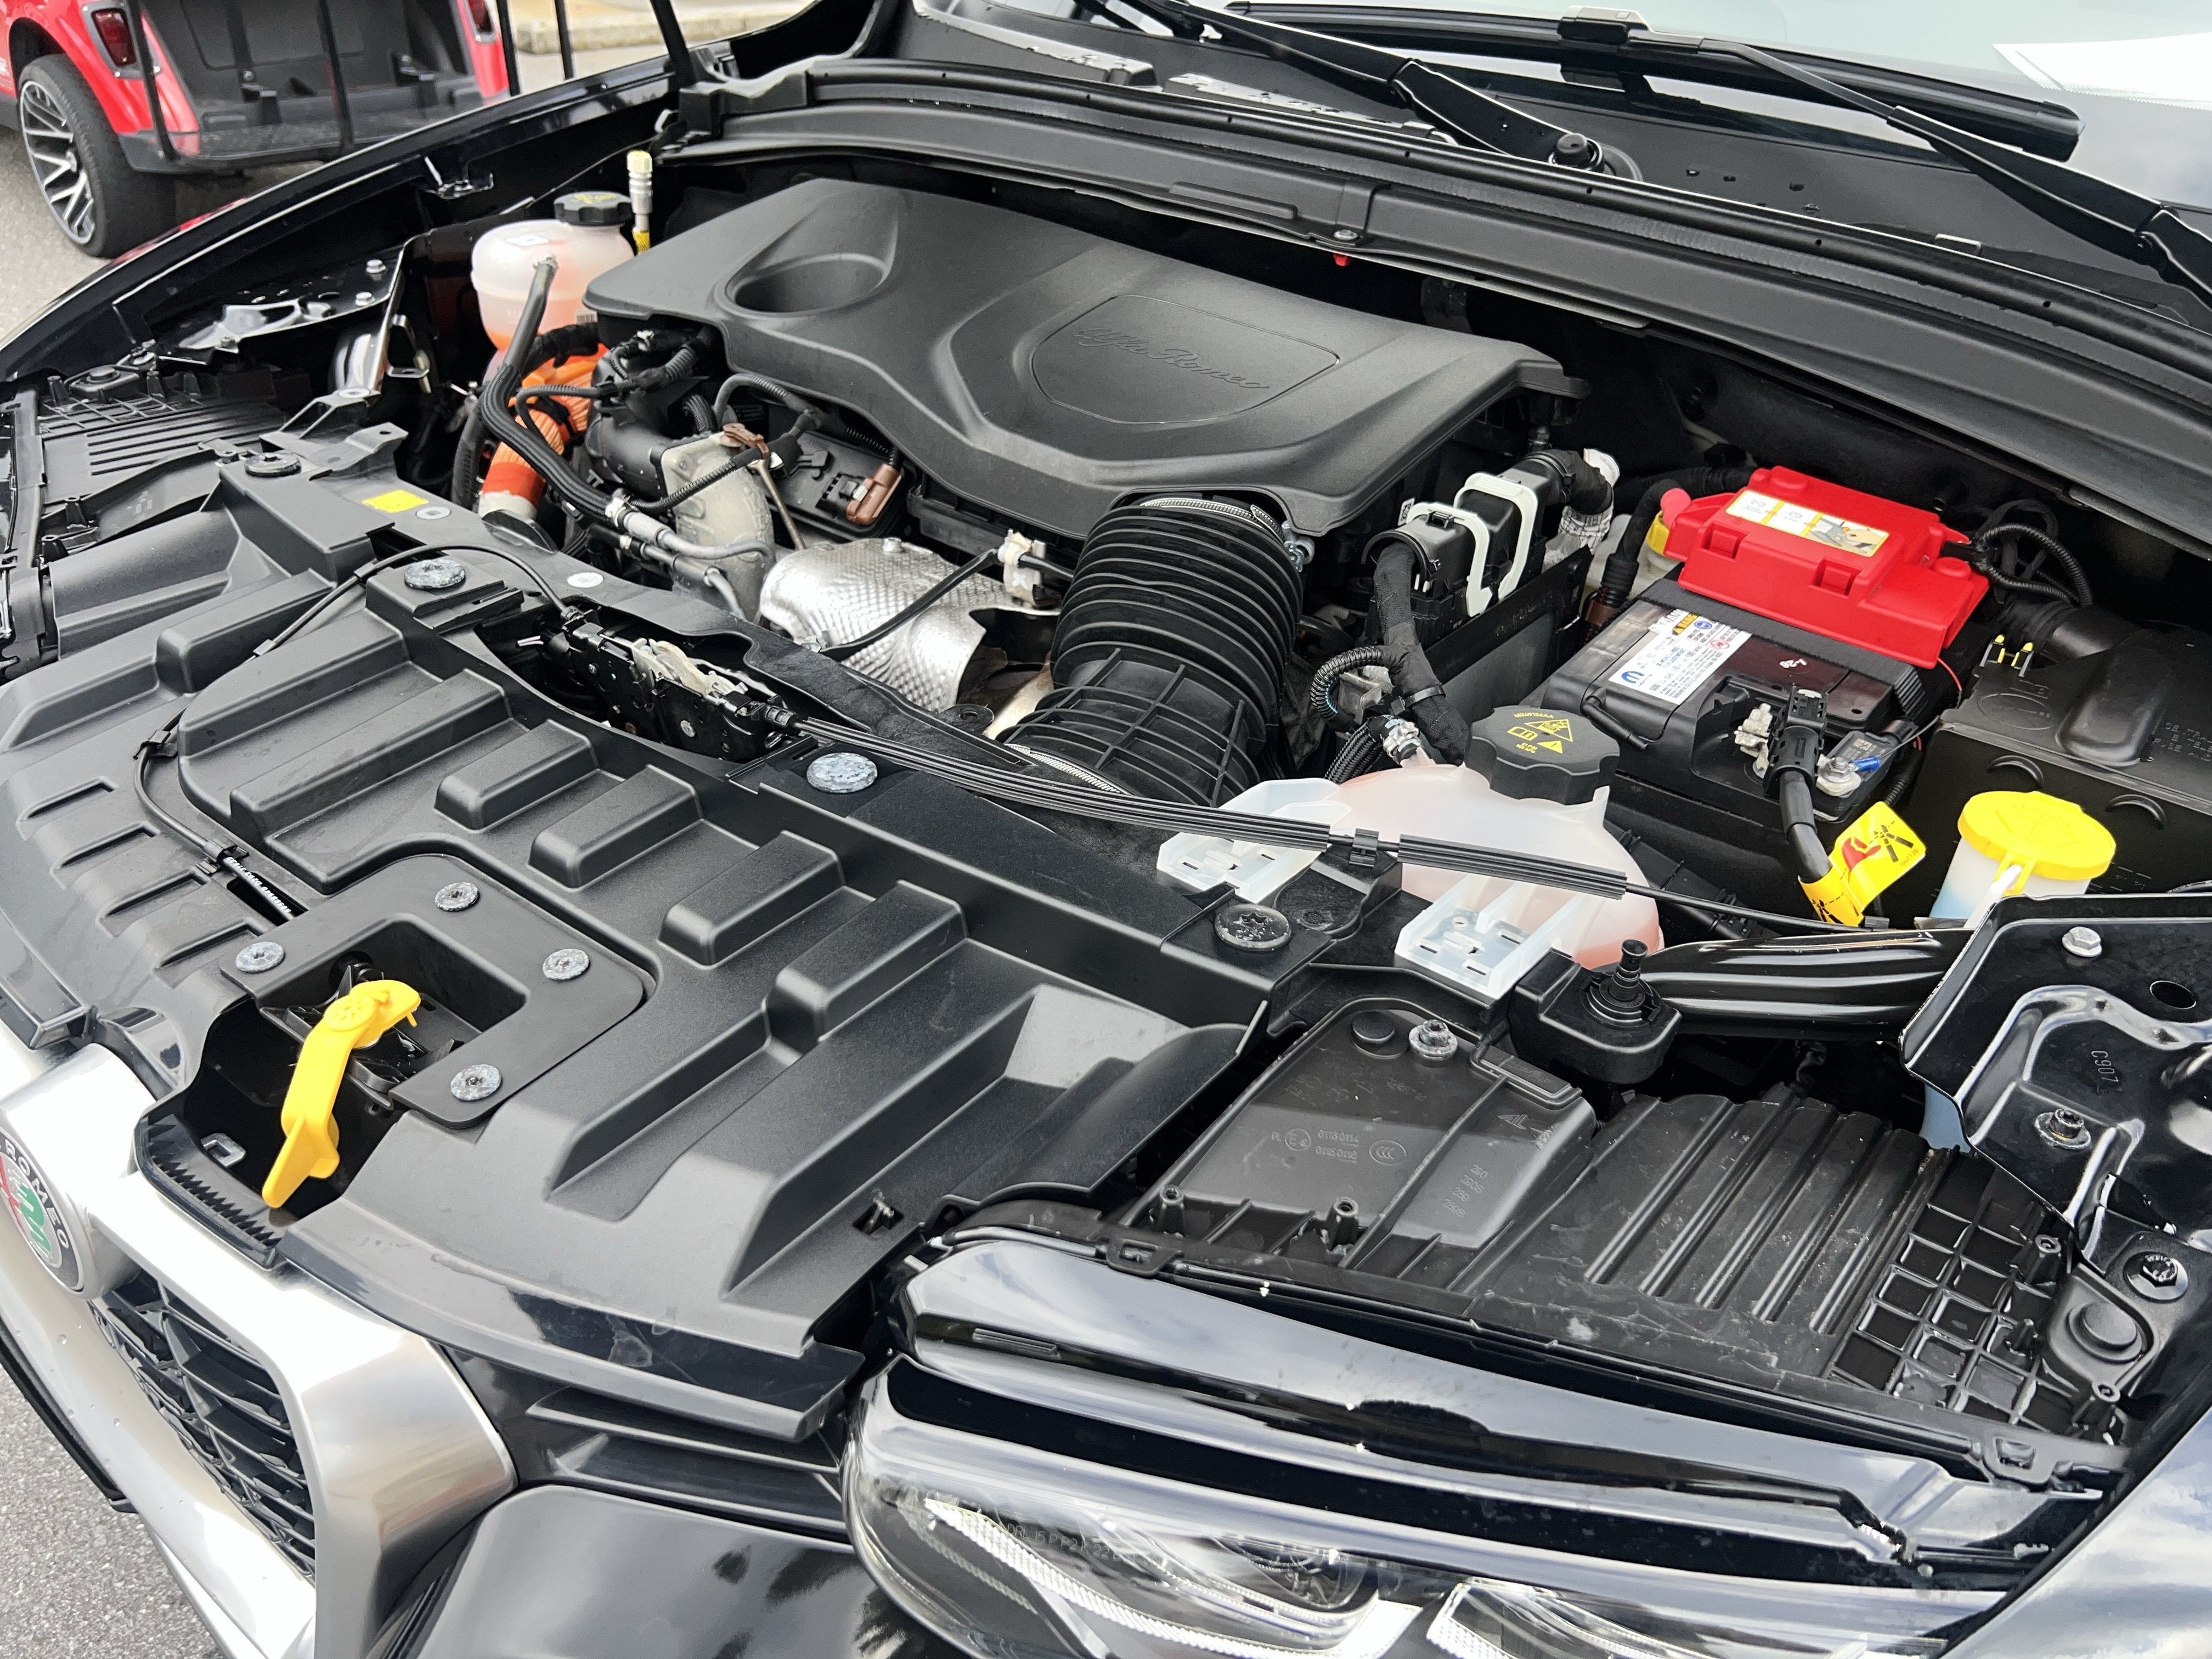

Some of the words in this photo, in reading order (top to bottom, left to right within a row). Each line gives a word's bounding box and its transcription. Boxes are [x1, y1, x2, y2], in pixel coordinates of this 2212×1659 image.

[1074, 328, 1149, 356] Alfa
[1144, 348, 1271, 390] Romeo
[2091, 1050, 2119, 1083] C907
[5, 1138, 70, 1249] ROMEO
